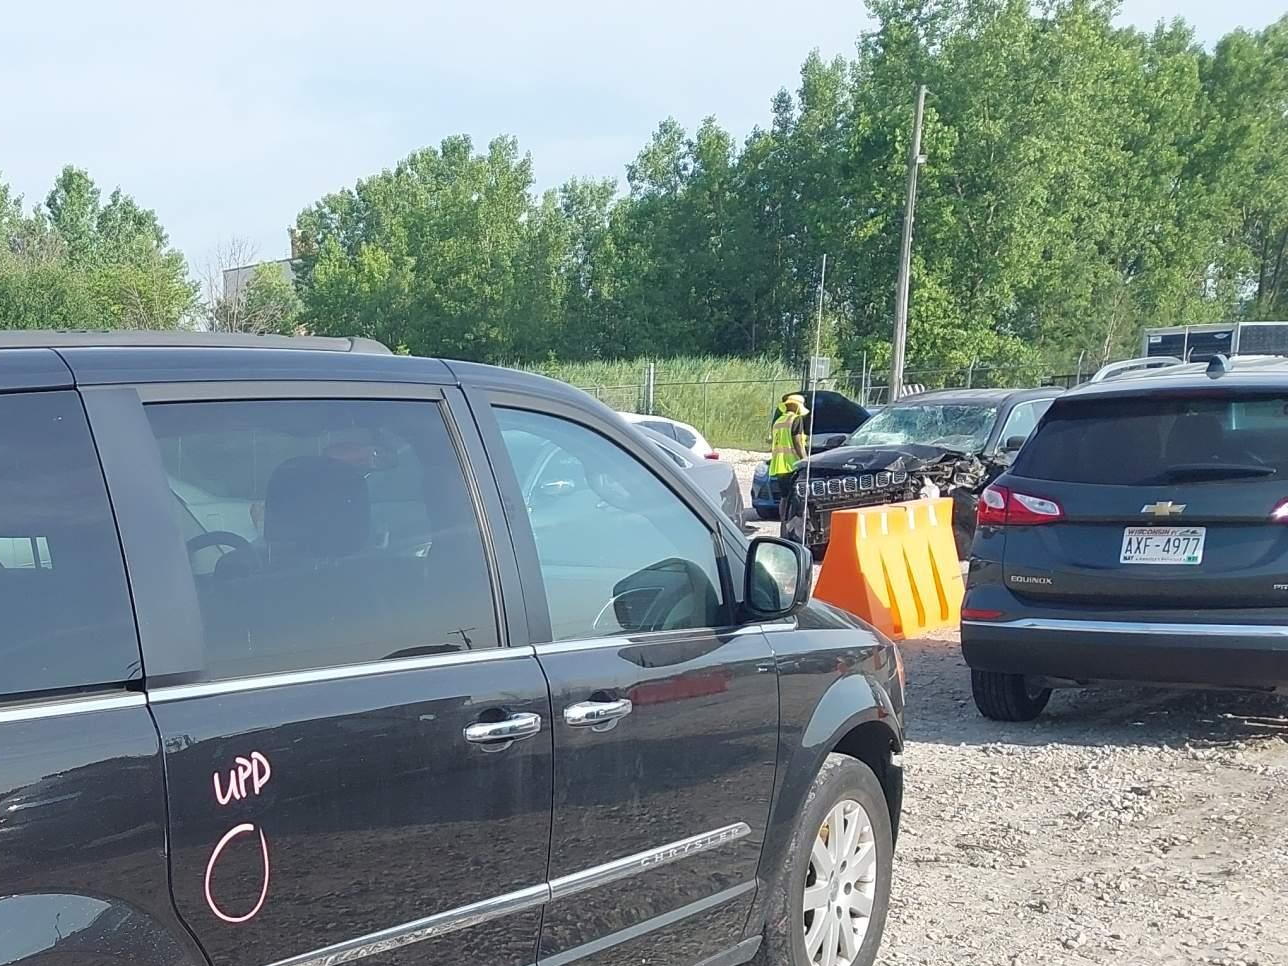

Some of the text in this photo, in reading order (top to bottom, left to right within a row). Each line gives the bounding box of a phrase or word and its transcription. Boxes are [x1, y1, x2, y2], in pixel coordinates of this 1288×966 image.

[1124, 536, 1201, 556] AXF-4977
[1010, 575, 1053, 585] EQUINOX
[640, 827, 739, 867] CHRYSLER
